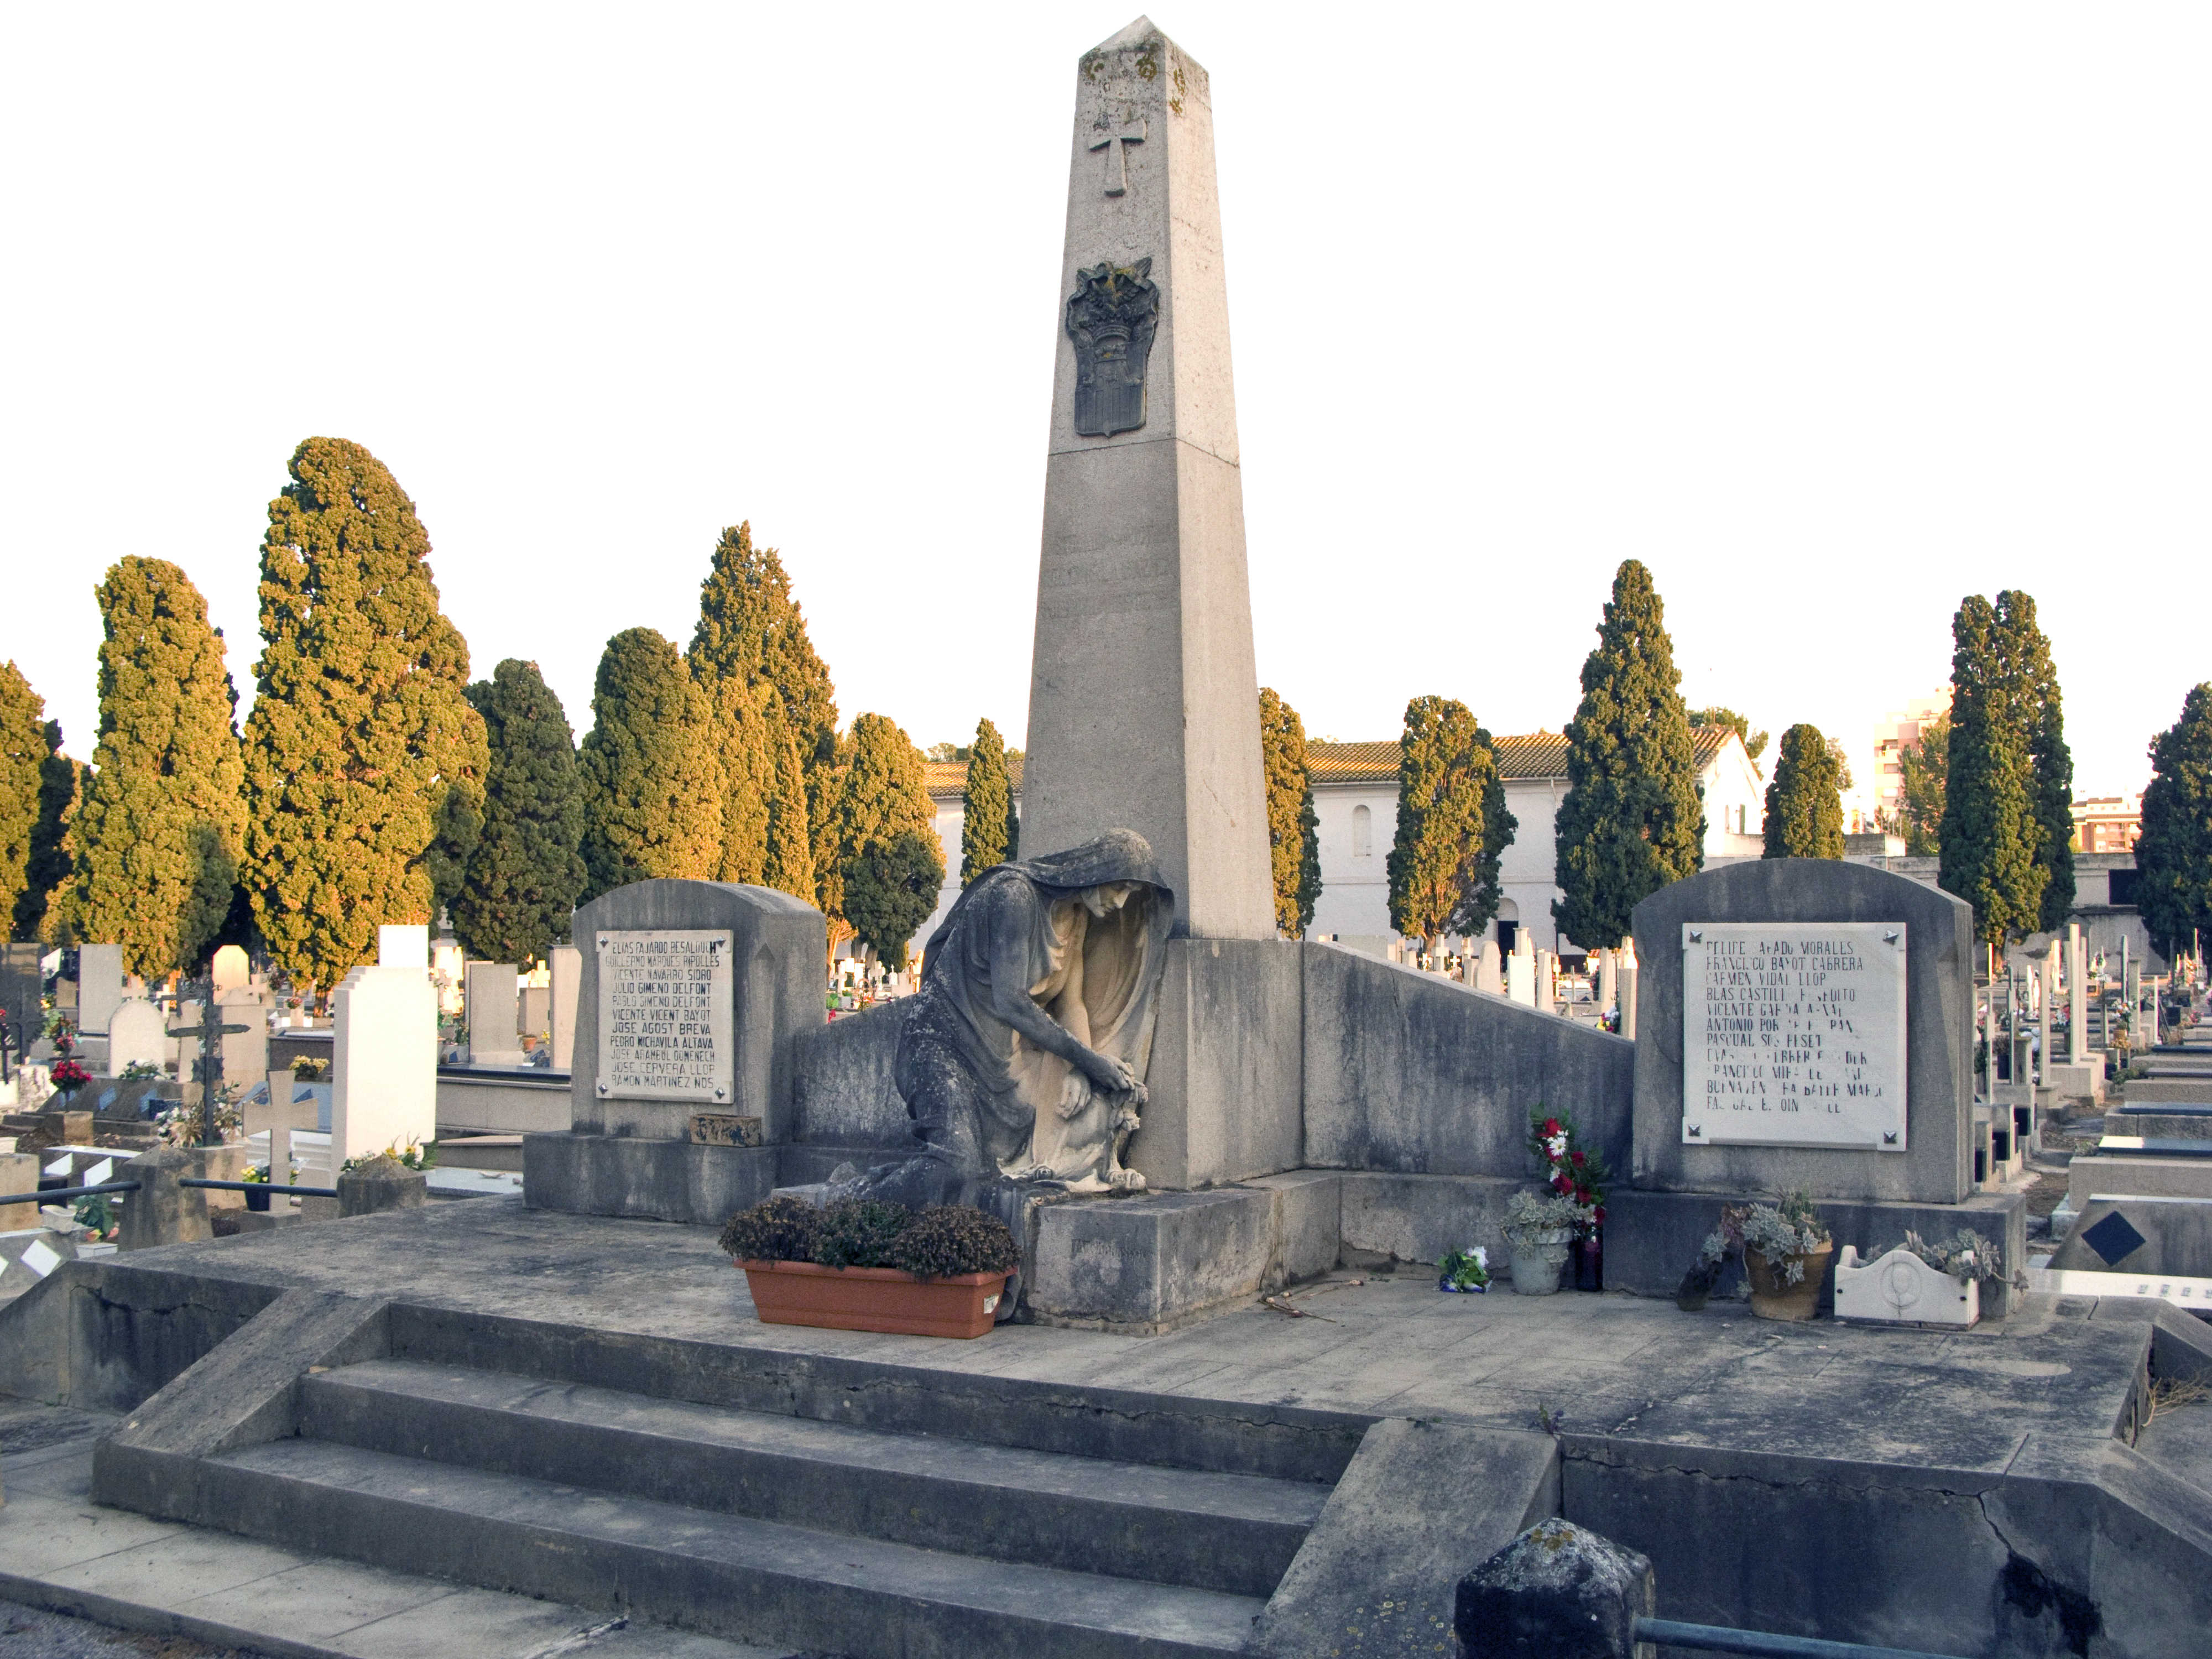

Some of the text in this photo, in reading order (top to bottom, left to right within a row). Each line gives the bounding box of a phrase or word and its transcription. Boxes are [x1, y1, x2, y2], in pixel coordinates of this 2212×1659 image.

[613, 941, 717, 955] ELIAS FAJARDO BESALDUCH
[1707, 941, 1745, 955] FELIPE
[1801, 941, 1854, 955] MORALES
[606, 955, 719, 968] GUILLERMO MARQUES RIPOLLES
[1707, 956, 1764, 971] FRANCICO
[1812, 957, 1863, 971] CABRERA
[614, 969, 711, 981] VICENTE NAVARRO SIDRO
[613, 982, 711, 995] JULIO GIMENO DELFONT
[1707, 987, 1734, 1000] BLAS
[612, 995, 711, 1008] PABLO GIMENO DELFONT
[612, 1009, 711, 1022] VICENTE VICENT BAYOT
[1707, 1003, 1754, 1016] VICENTE
[612, 1022, 711, 1035] JOSE AGOST BREVA
[1707, 1018, 1753, 1031] ANTONIO
[610, 1036, 713, 1049] PEDRO MICHAVILA ALTAVA
[1707, 1033, 1754, 1047] PASCUAL
[611, 1048, 631, 1060] JOSE
[674, 1050, 715, 1062] DOMENECH
[612, 1062, 715, 1075] JOSE CERVERA LLOP
[612, 1074, 714, 1089] RAMON MARTINEZ NOS
